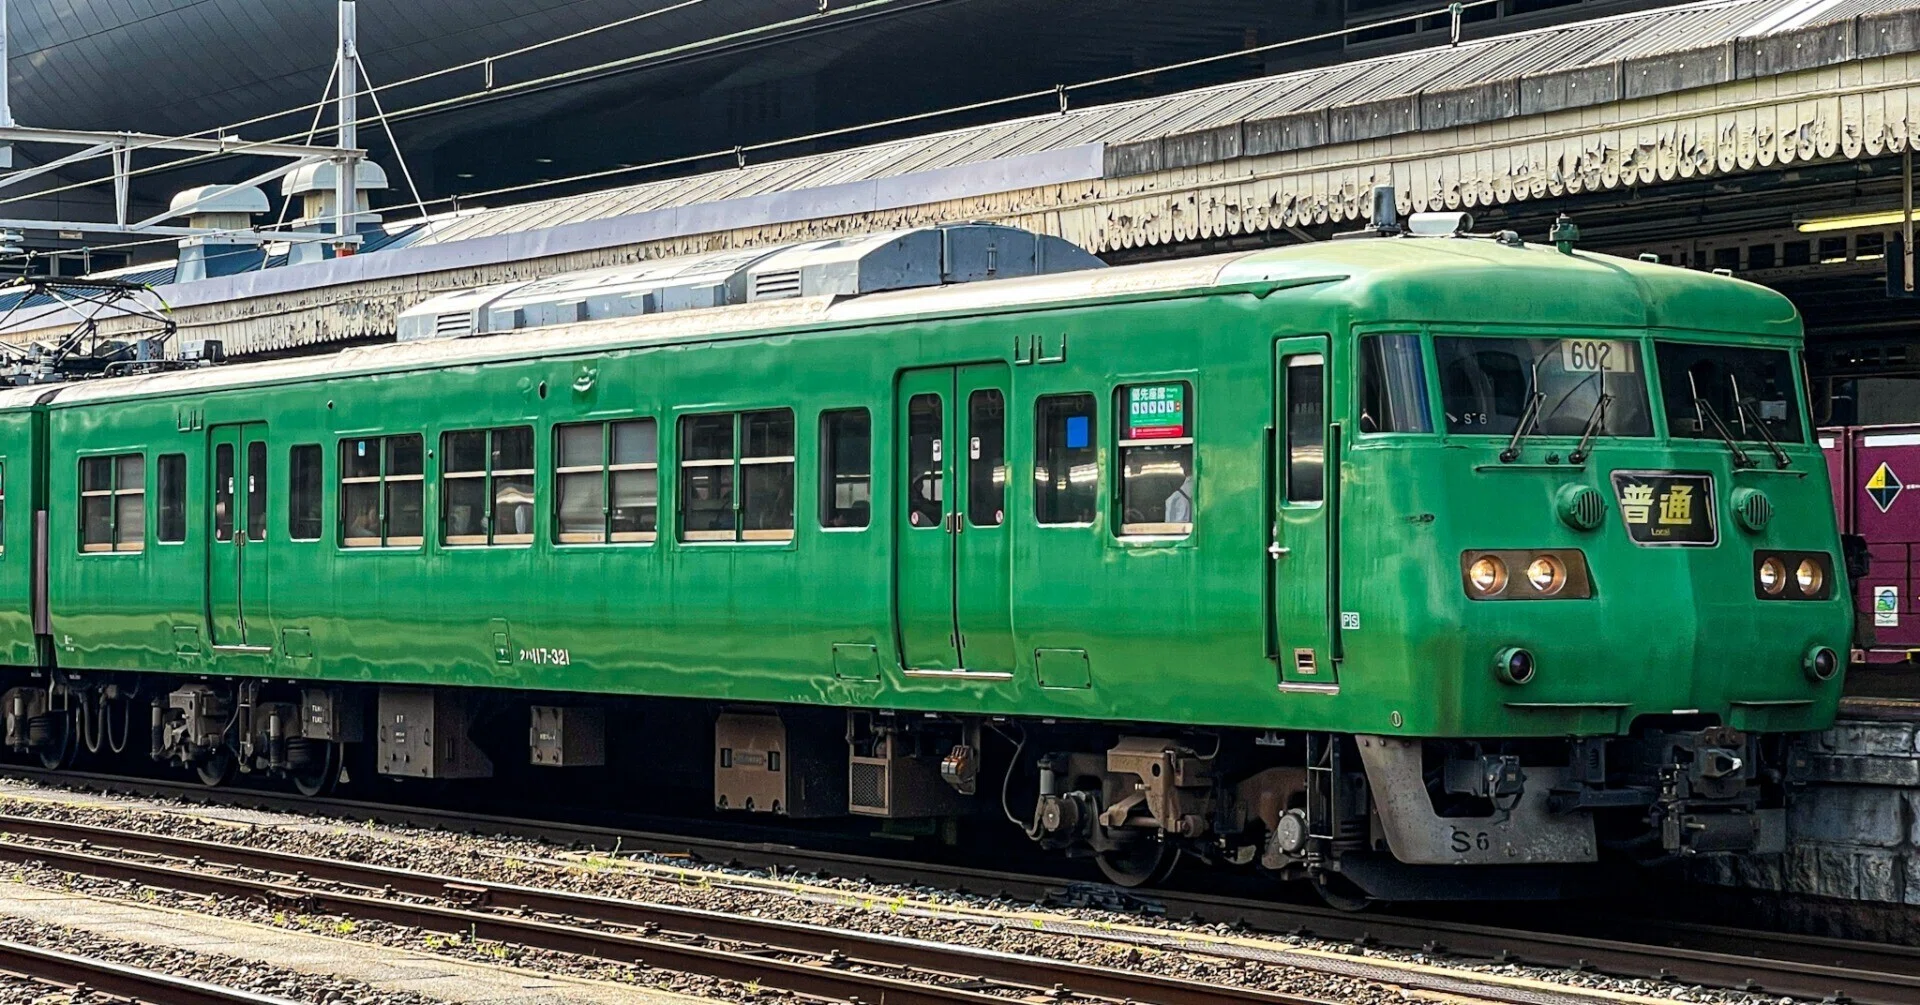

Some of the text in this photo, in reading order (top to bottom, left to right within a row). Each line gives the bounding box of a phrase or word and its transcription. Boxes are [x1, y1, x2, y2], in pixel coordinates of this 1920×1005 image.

[1571, 341, 1612, 370] 602
[1621, 484, 1694, 525] 普通
[1651, 527, 1671, 536] Local
